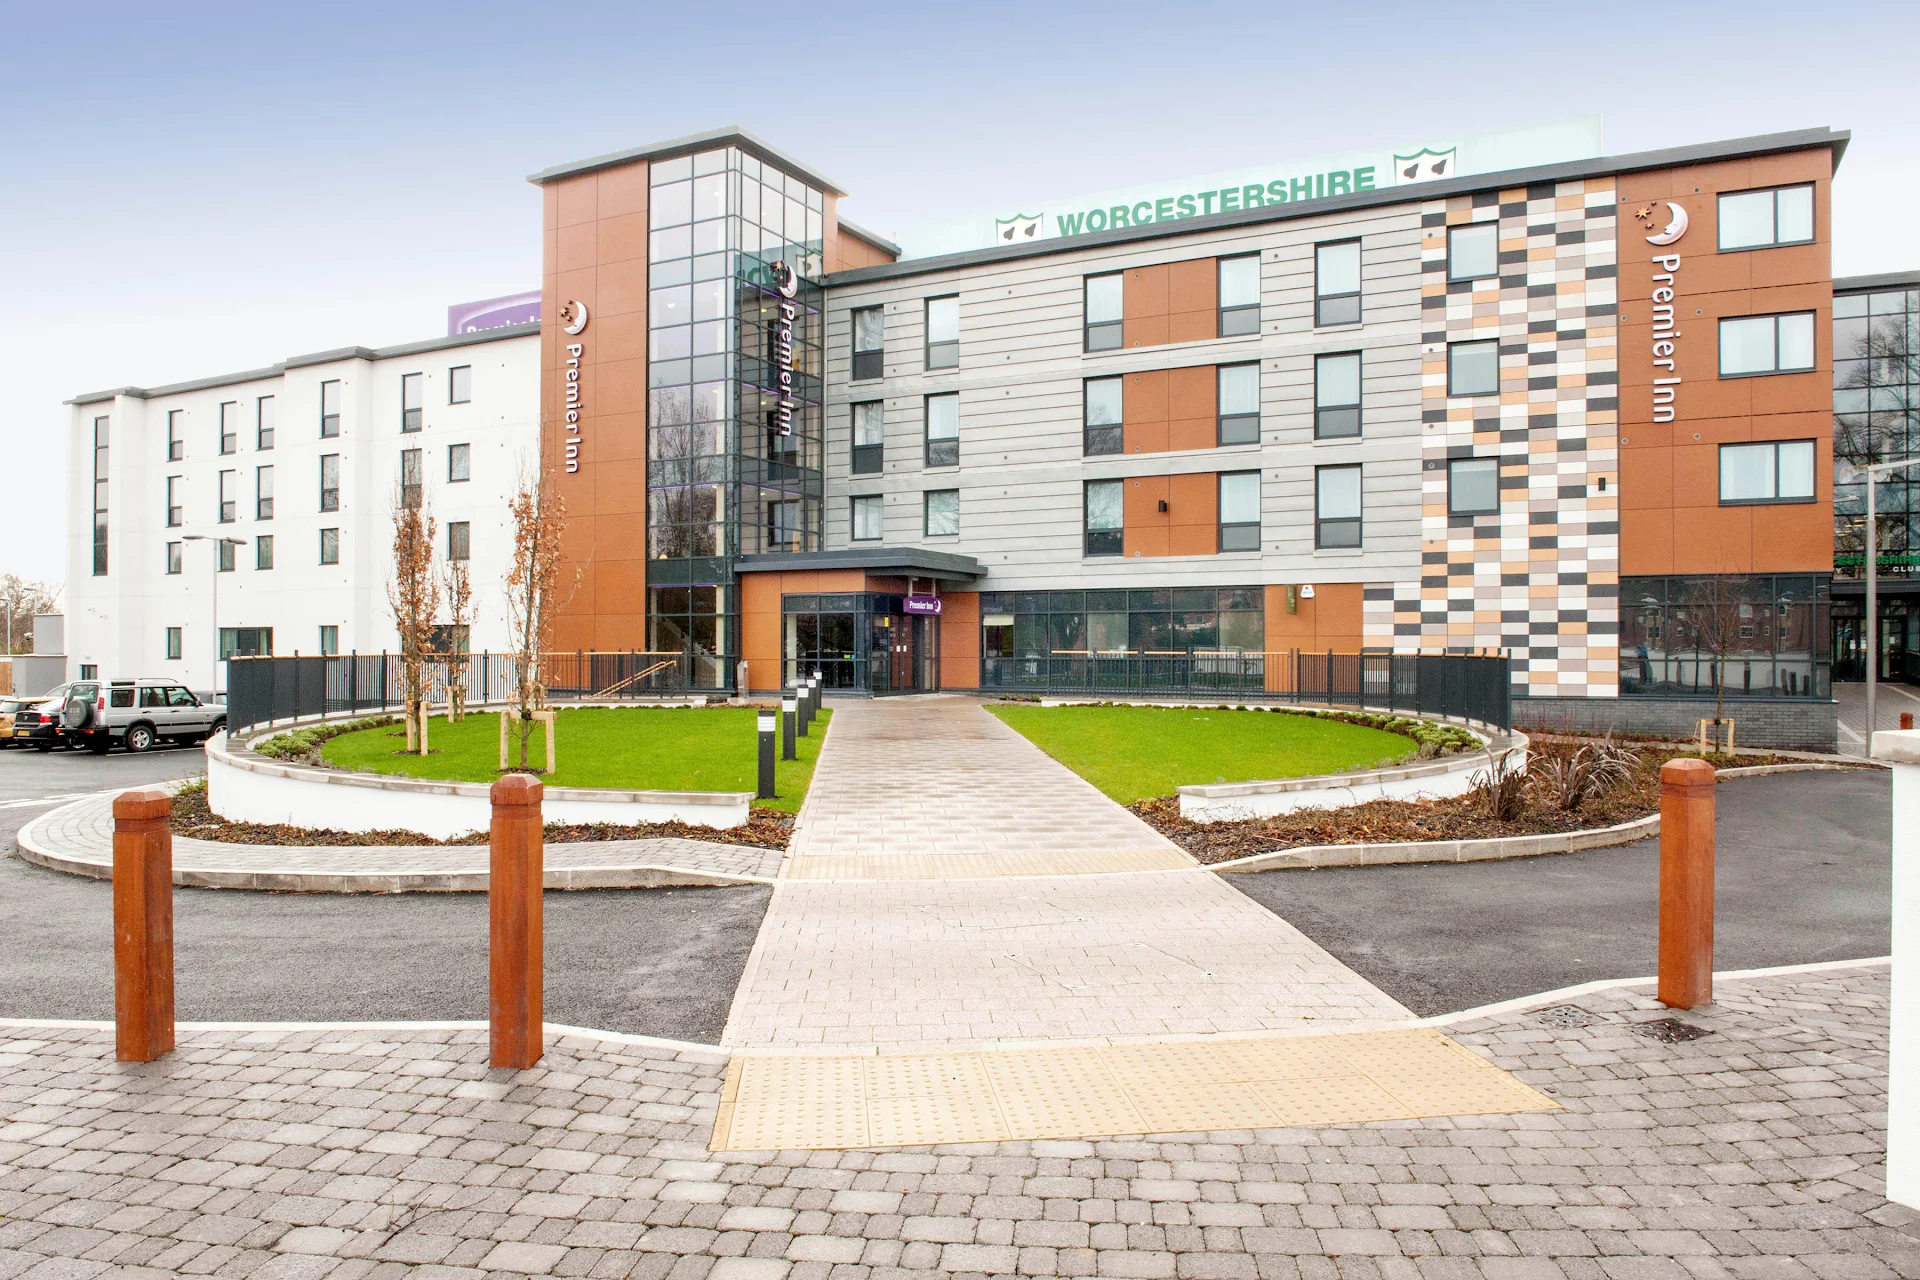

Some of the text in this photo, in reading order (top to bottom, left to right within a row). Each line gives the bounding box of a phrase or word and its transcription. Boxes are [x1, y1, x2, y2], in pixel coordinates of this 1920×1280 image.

[1057, 166, 1376, 237] WORCESTERSHIRE
[778, 303, 795, 437] Premier Inn
[1651, 253, 1682, 423] Premier Inn
[565, 343, 583, 474] Premier Inn
[909, 600, 934, 610] Premier Inn
